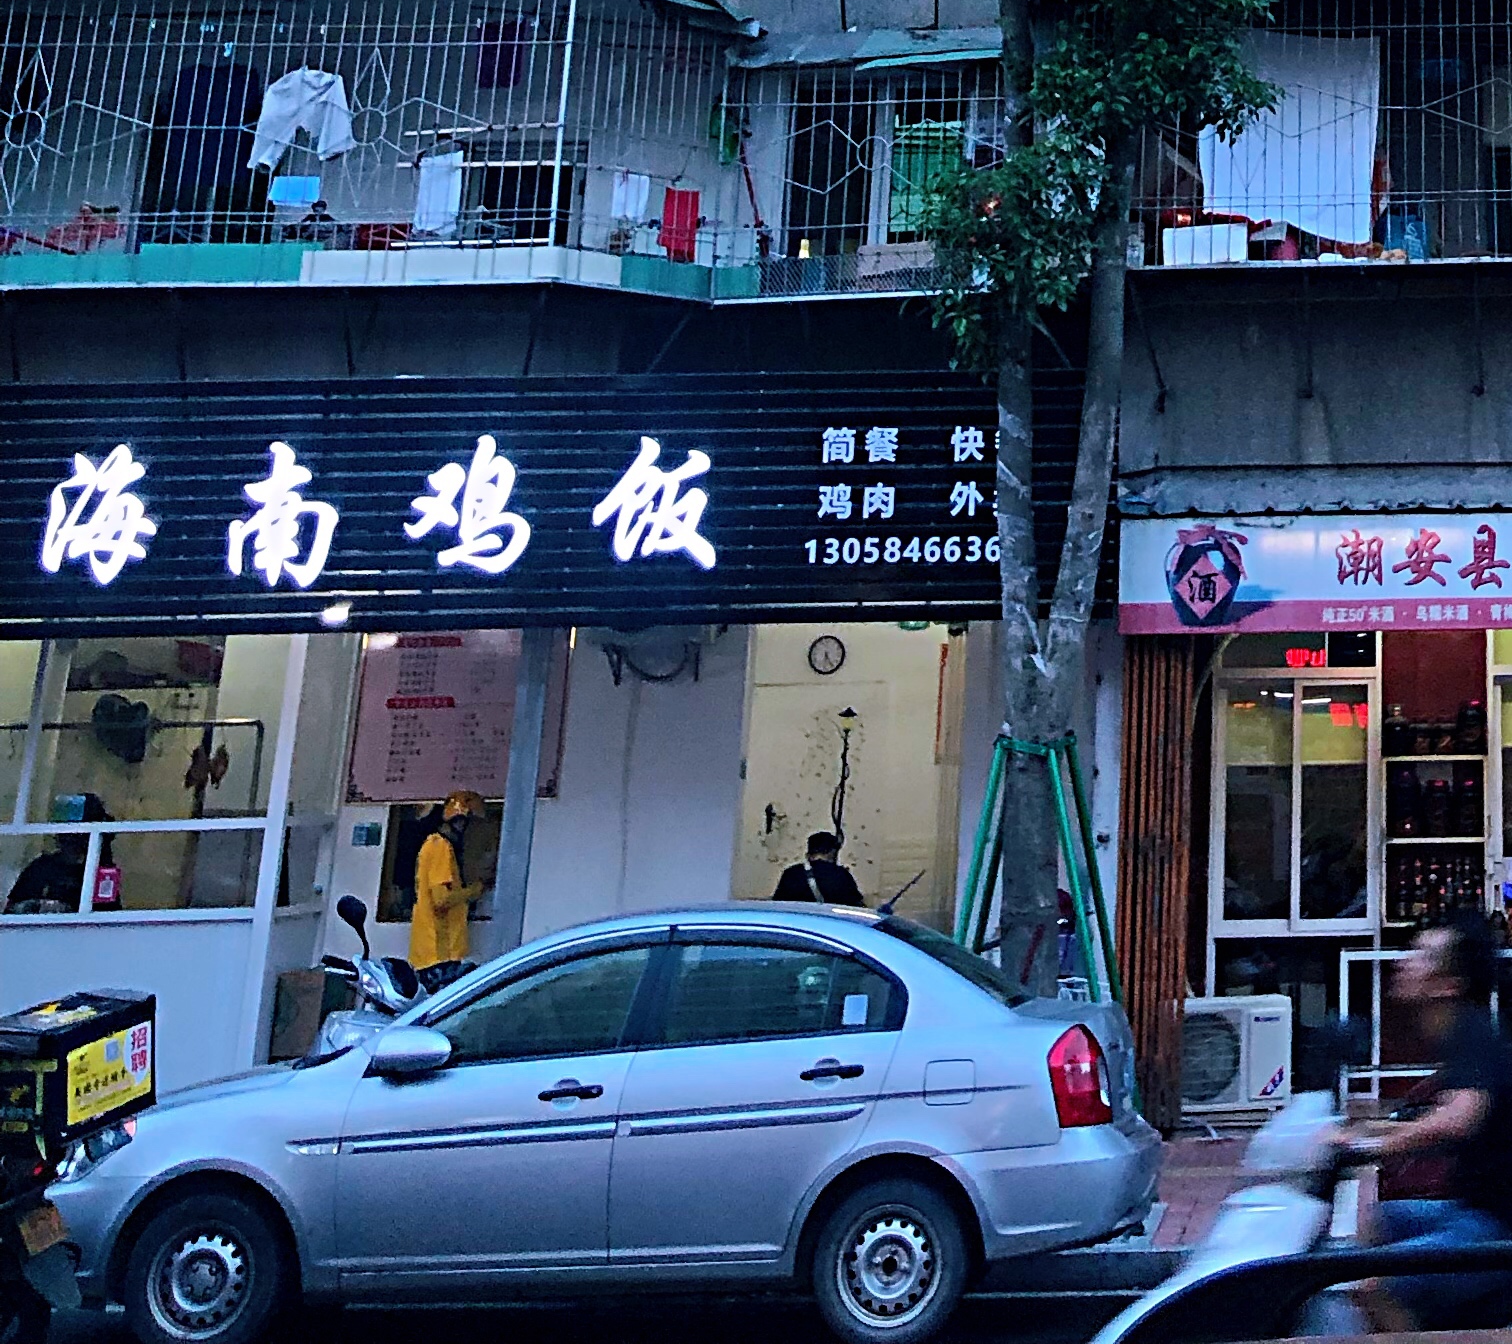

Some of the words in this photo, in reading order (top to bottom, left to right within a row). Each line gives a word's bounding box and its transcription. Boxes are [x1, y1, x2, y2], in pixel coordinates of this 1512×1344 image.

[822, 427, 899, 463] 简餐
[951, 426, 1001, 463] 快
[40, 434, 718, 587] 海南鸡饭
[818, 483, 896, 519] 鸡肉
[949, 481, 999, 517] 外
[1187, 570, 1219, 603] 酒
[131, 1026, 148, 1073] 招聘
